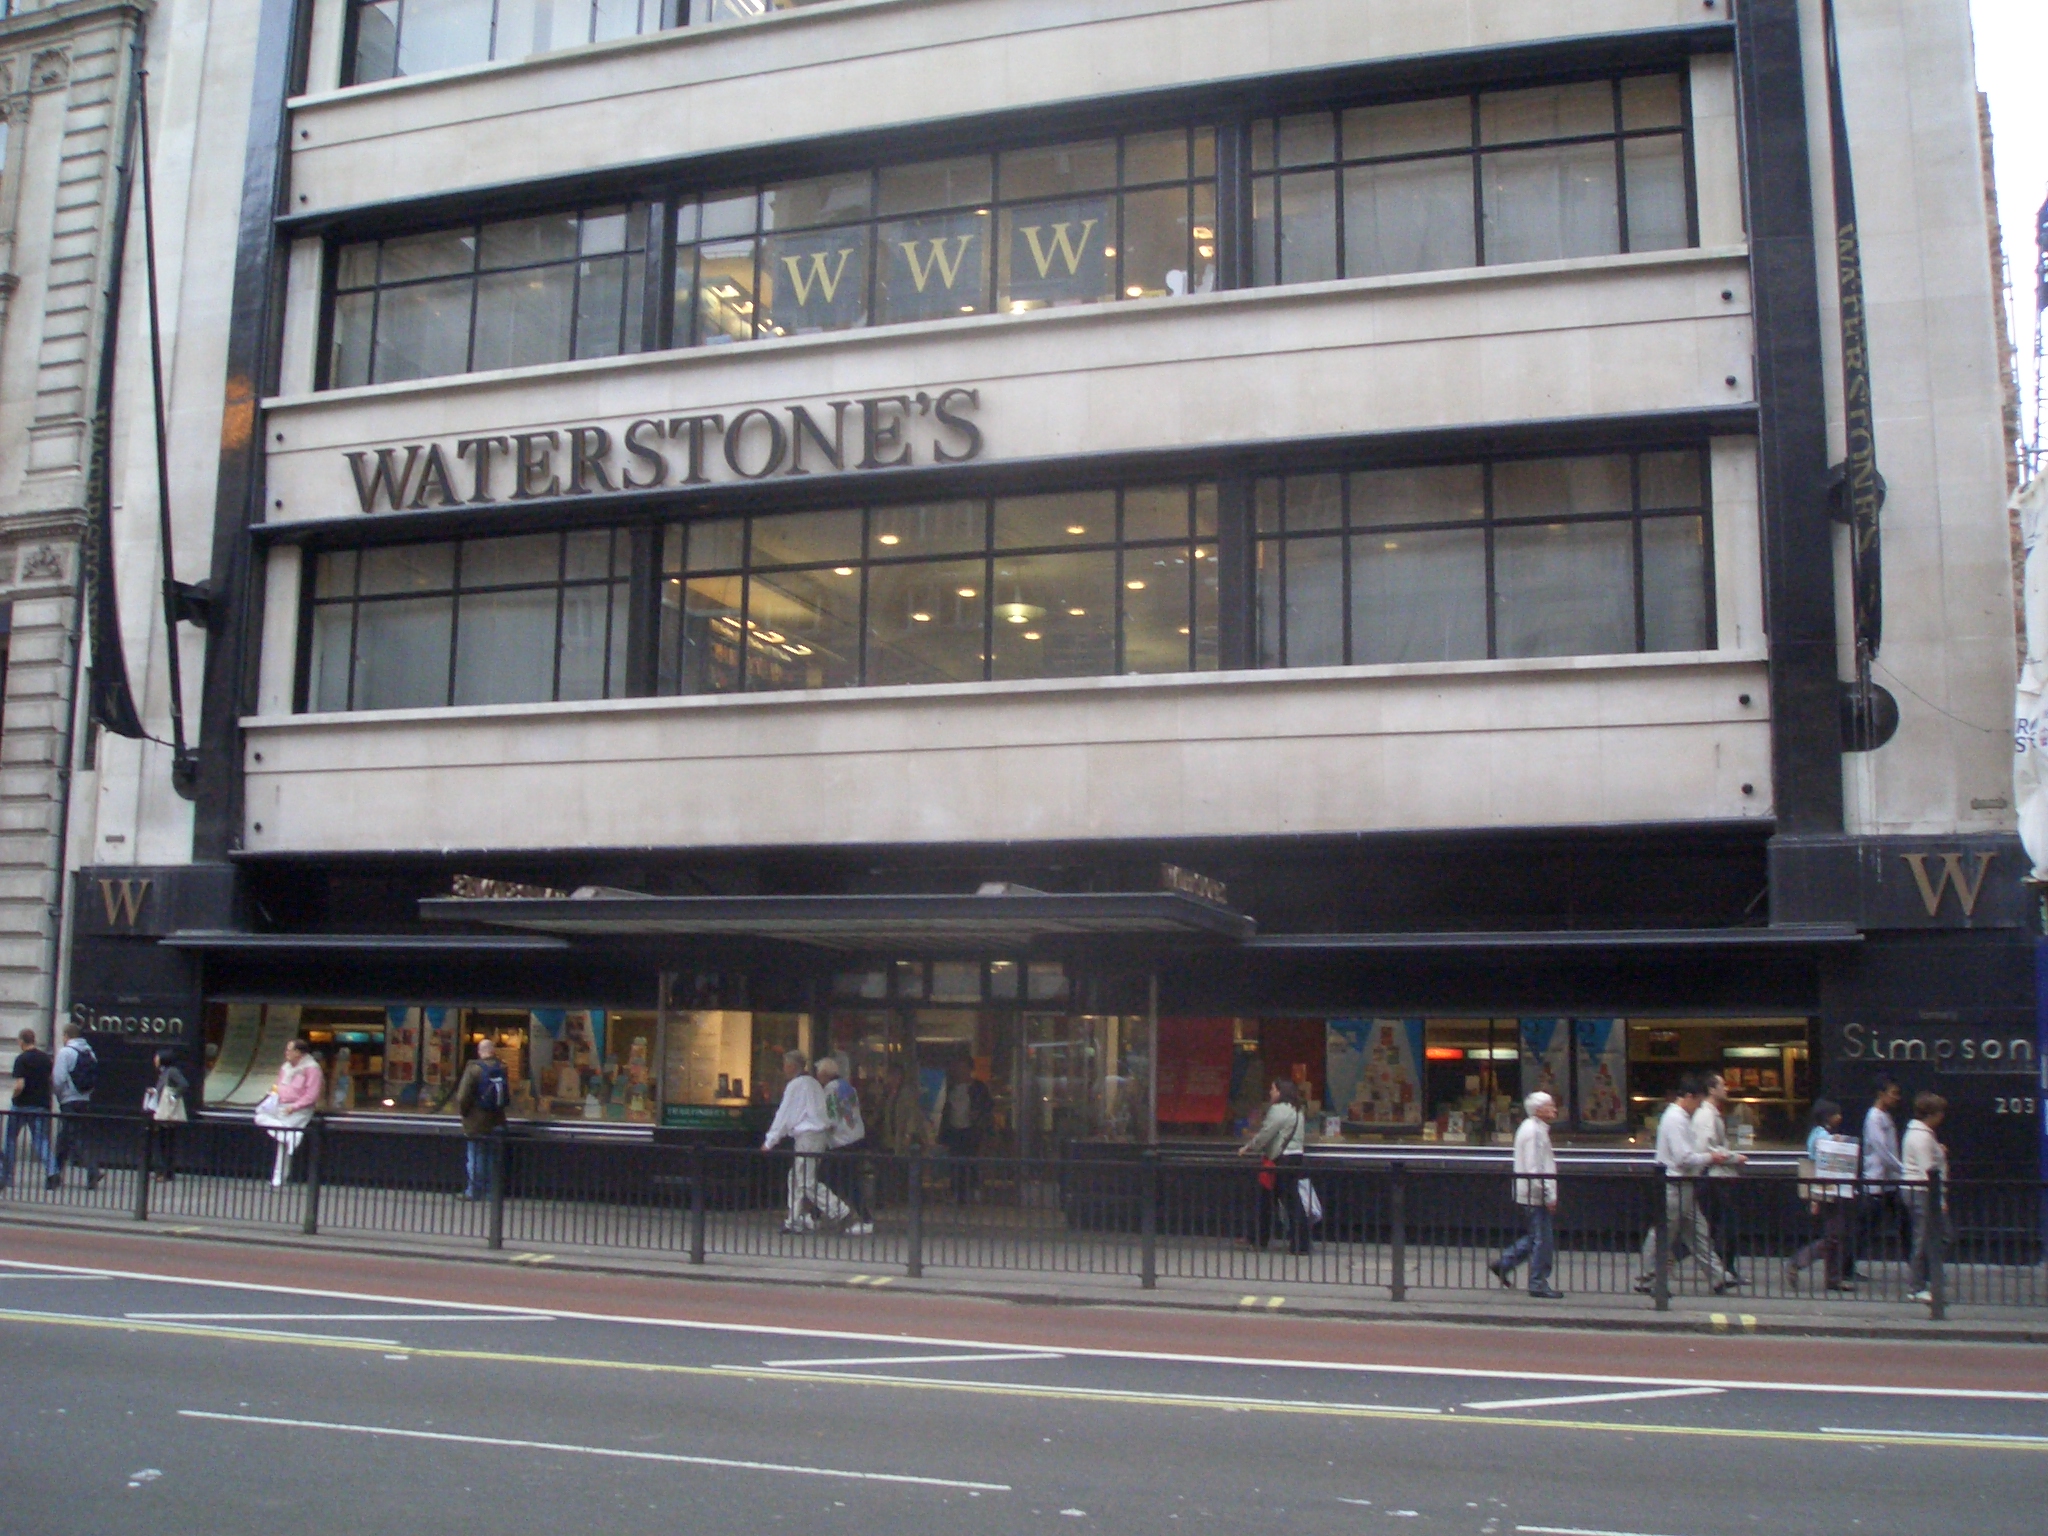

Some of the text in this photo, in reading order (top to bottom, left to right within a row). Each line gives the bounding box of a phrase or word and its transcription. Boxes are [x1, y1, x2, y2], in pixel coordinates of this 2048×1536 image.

[781, 248, 855, 307] W
[899, 234, 974, 293] W
[1018, 219, 1098, 279] W
[342, 387, 984, 514] WATERSTONE'S
[98, 878, 151, 926] W
[1899, 852, 1999, 917] W
[73, 1002, 184, 1038] Simpson
[1843, 1022, 2034, 1064] Simpson
[1994, 1096, 2036, 1115] 203
